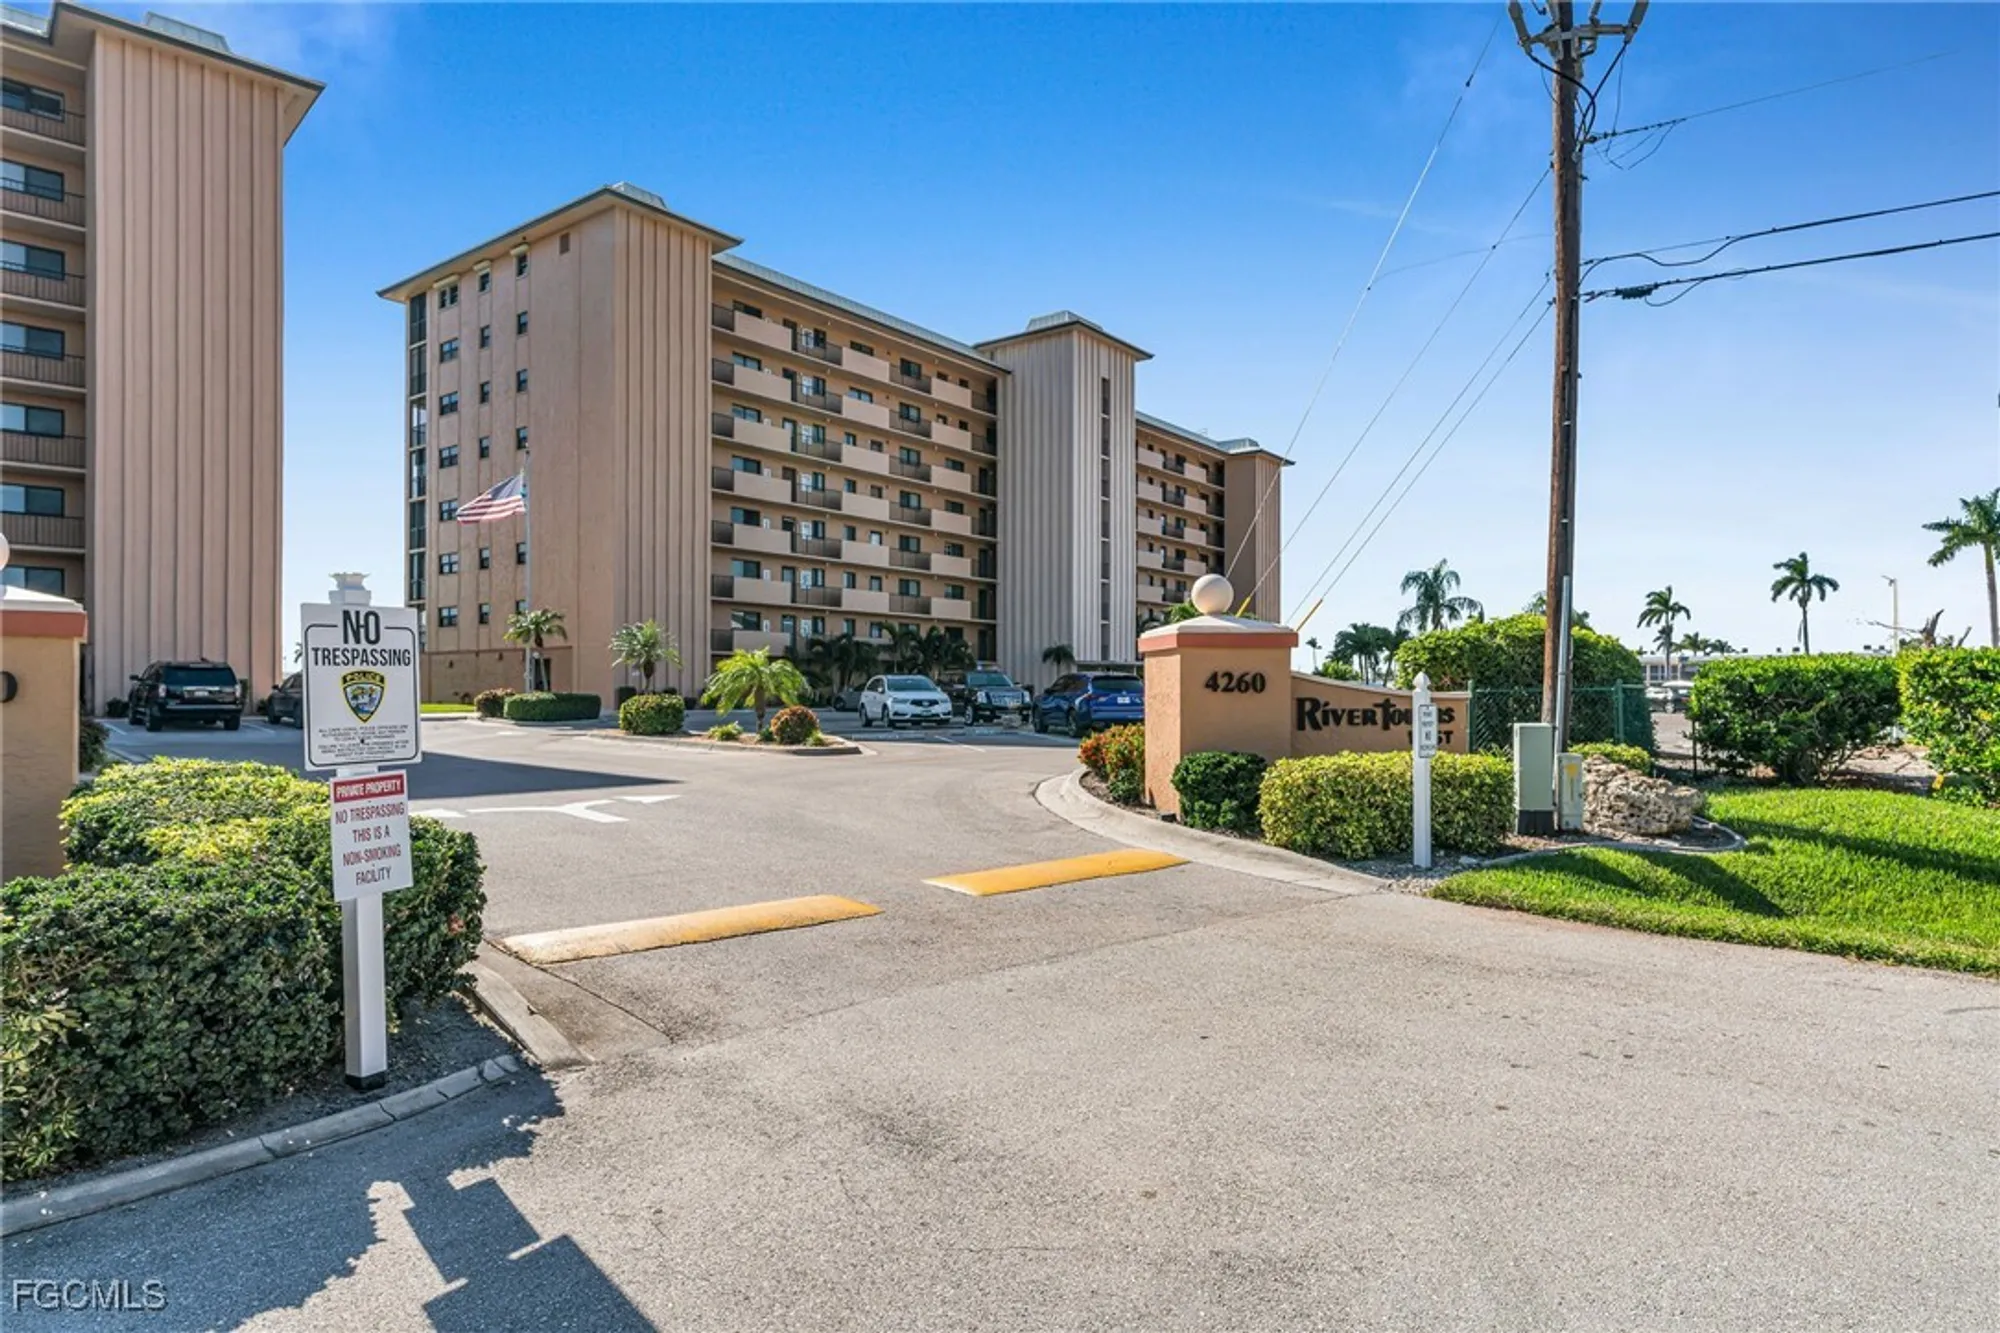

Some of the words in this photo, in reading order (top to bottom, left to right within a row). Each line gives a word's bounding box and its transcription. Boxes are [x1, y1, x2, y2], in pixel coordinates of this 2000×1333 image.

[342, 609, 381, 645] NO
[311, 646, 411, 667] TRESPASSING
[1204, 671, 1267, 694] 4260
[335, 783, 365, 799] PRIVATE
[365, 779, 401, 795] PROPERTY
[335, 809, 348, 824] NO
[350, 801, 405, 821] TRESPASSING
[352, 827, 372, 843] THIS
[374, 826, 382, 840] IS
[384, 824, 391, 838] A
[343, 843, 402, 867] NON-SMOKING
[355, 866, 392, 886] FACILITY
